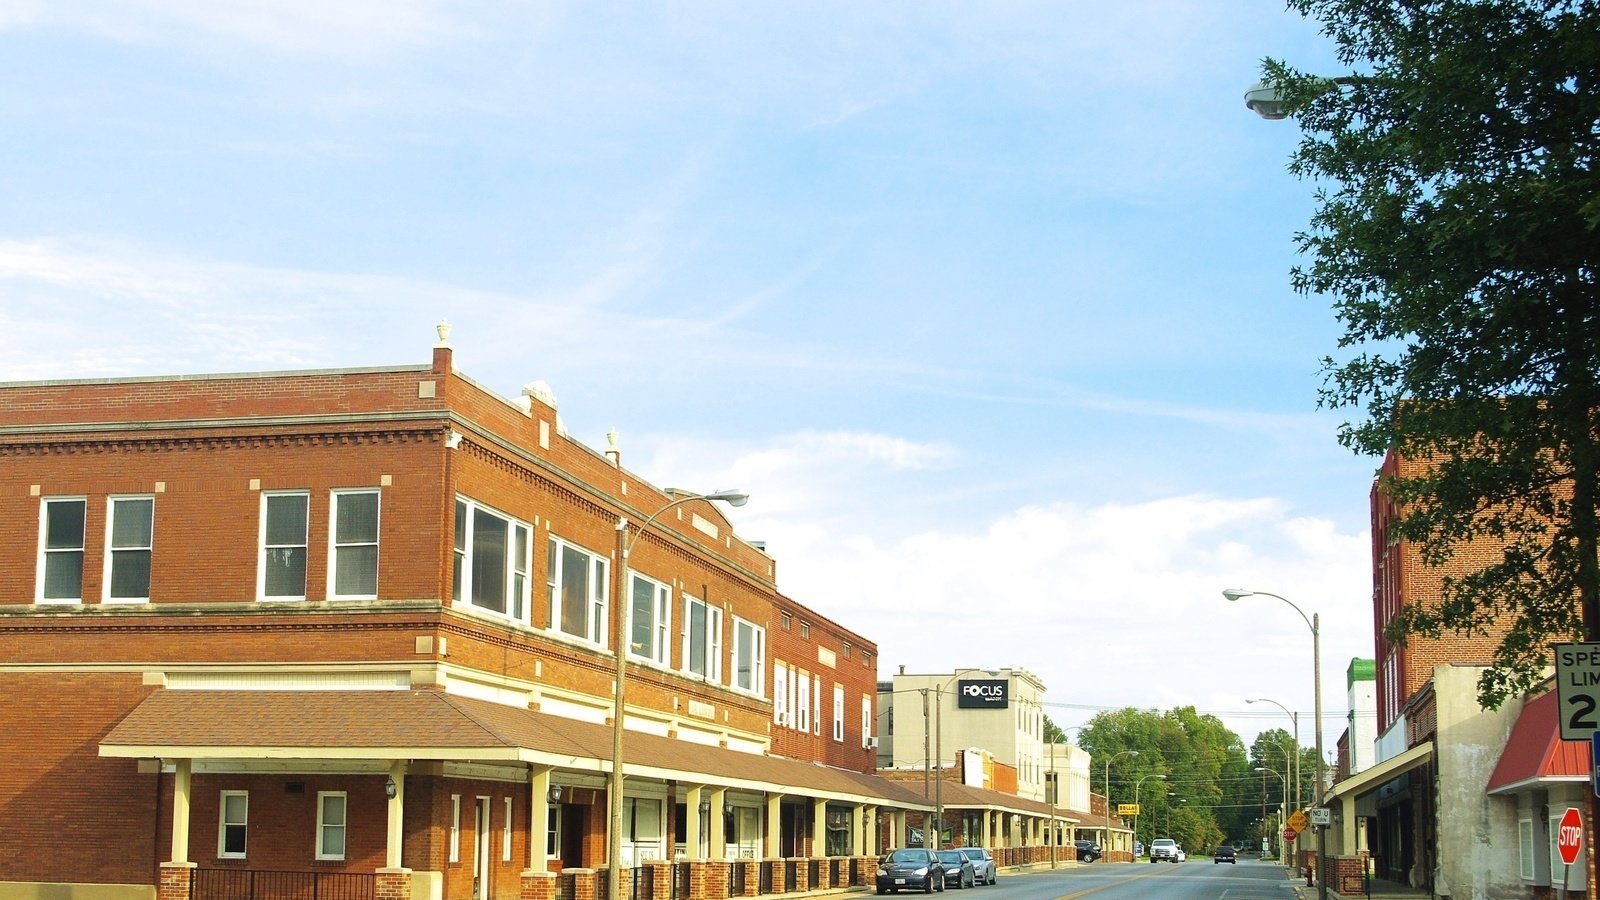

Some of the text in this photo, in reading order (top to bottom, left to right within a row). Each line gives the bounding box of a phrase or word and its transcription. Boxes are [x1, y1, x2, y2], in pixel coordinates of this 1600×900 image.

[963, 685, 1002, 696] FOCUS
[1567, 694, 1597, 729] 2
[1560, 826, 1581, 846] STOP
